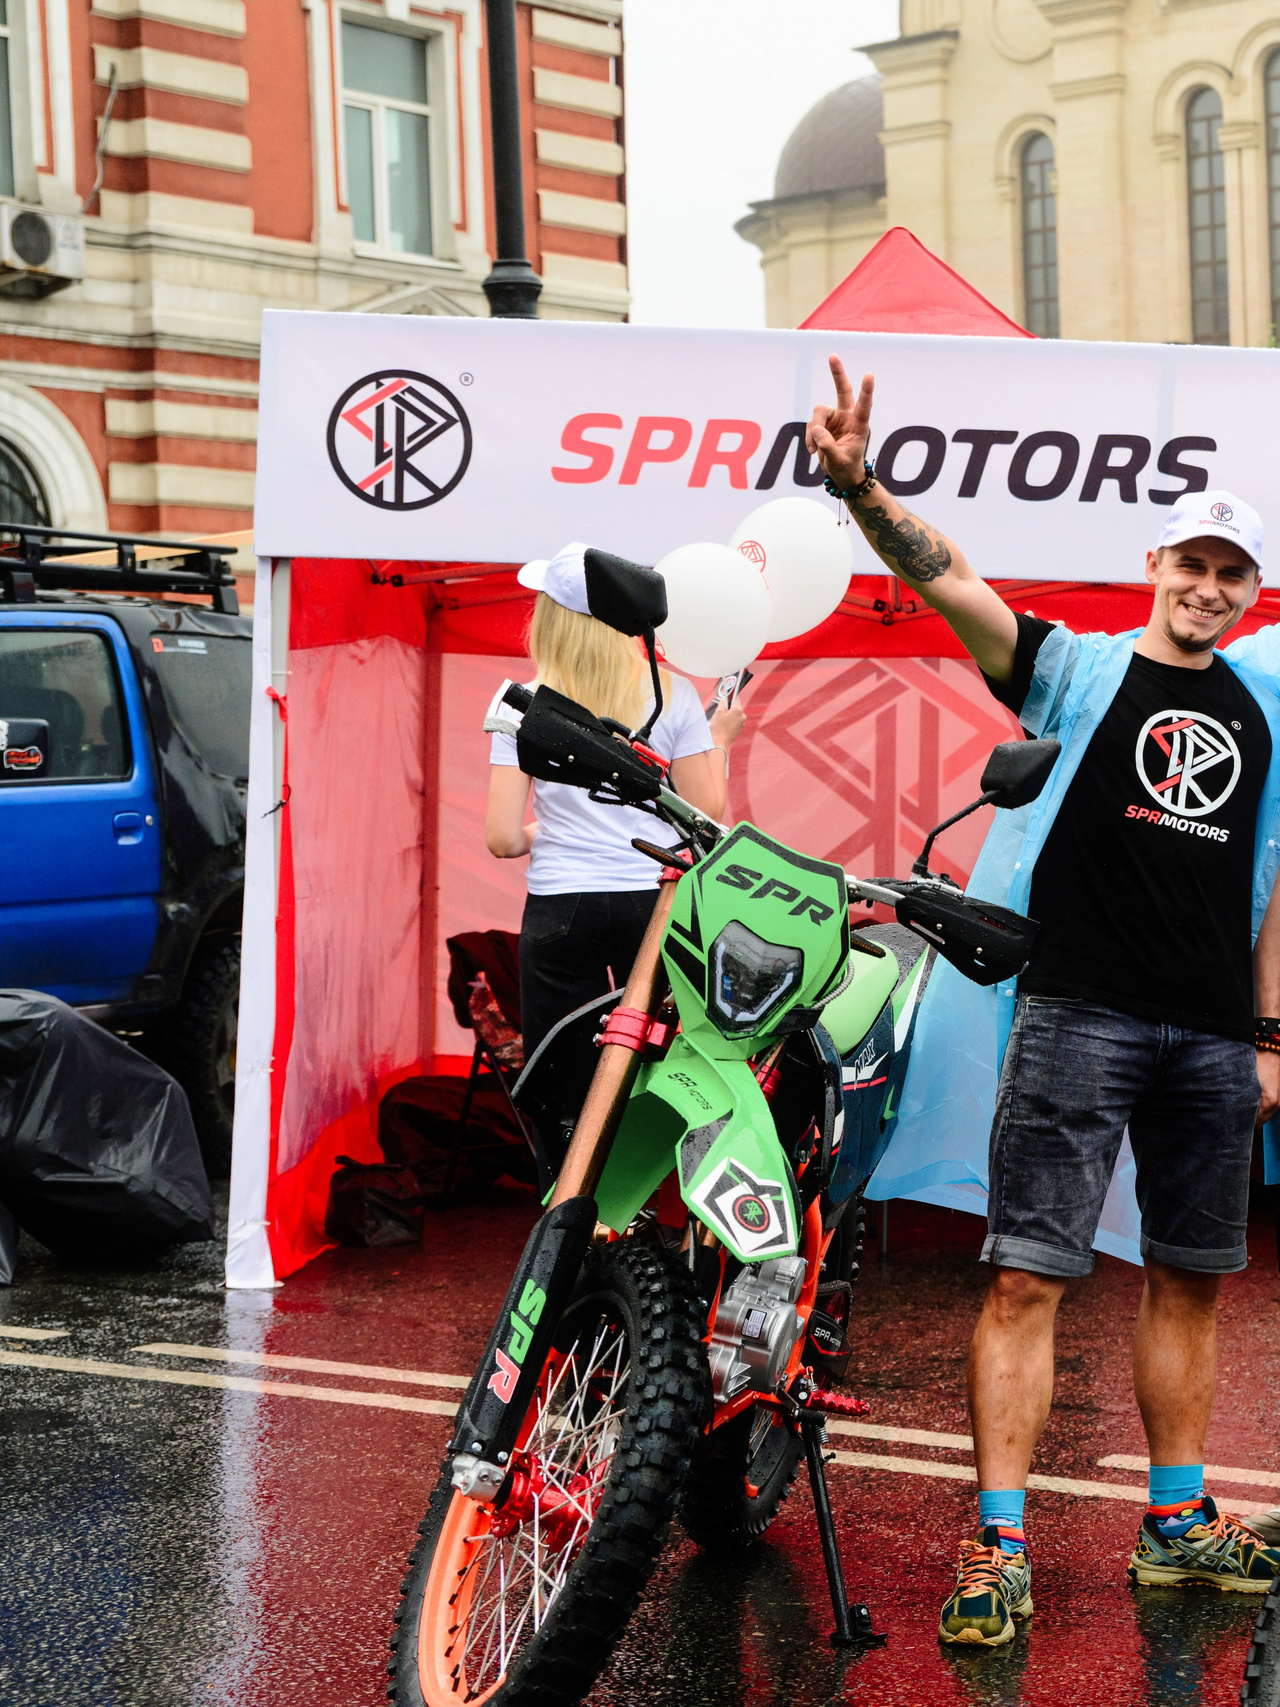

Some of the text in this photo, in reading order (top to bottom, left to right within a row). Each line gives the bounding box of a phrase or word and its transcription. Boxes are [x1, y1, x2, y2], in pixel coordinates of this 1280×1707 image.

[1198, 519, 1241, 534] SPRMOTORS
[1124, 804, 1230, 843] SPRMOTORS
[716, 864, 835, 927] SPR
[854, 1037, 876, 1091] MAX
[487, 1278, 547, 1404] SPR
